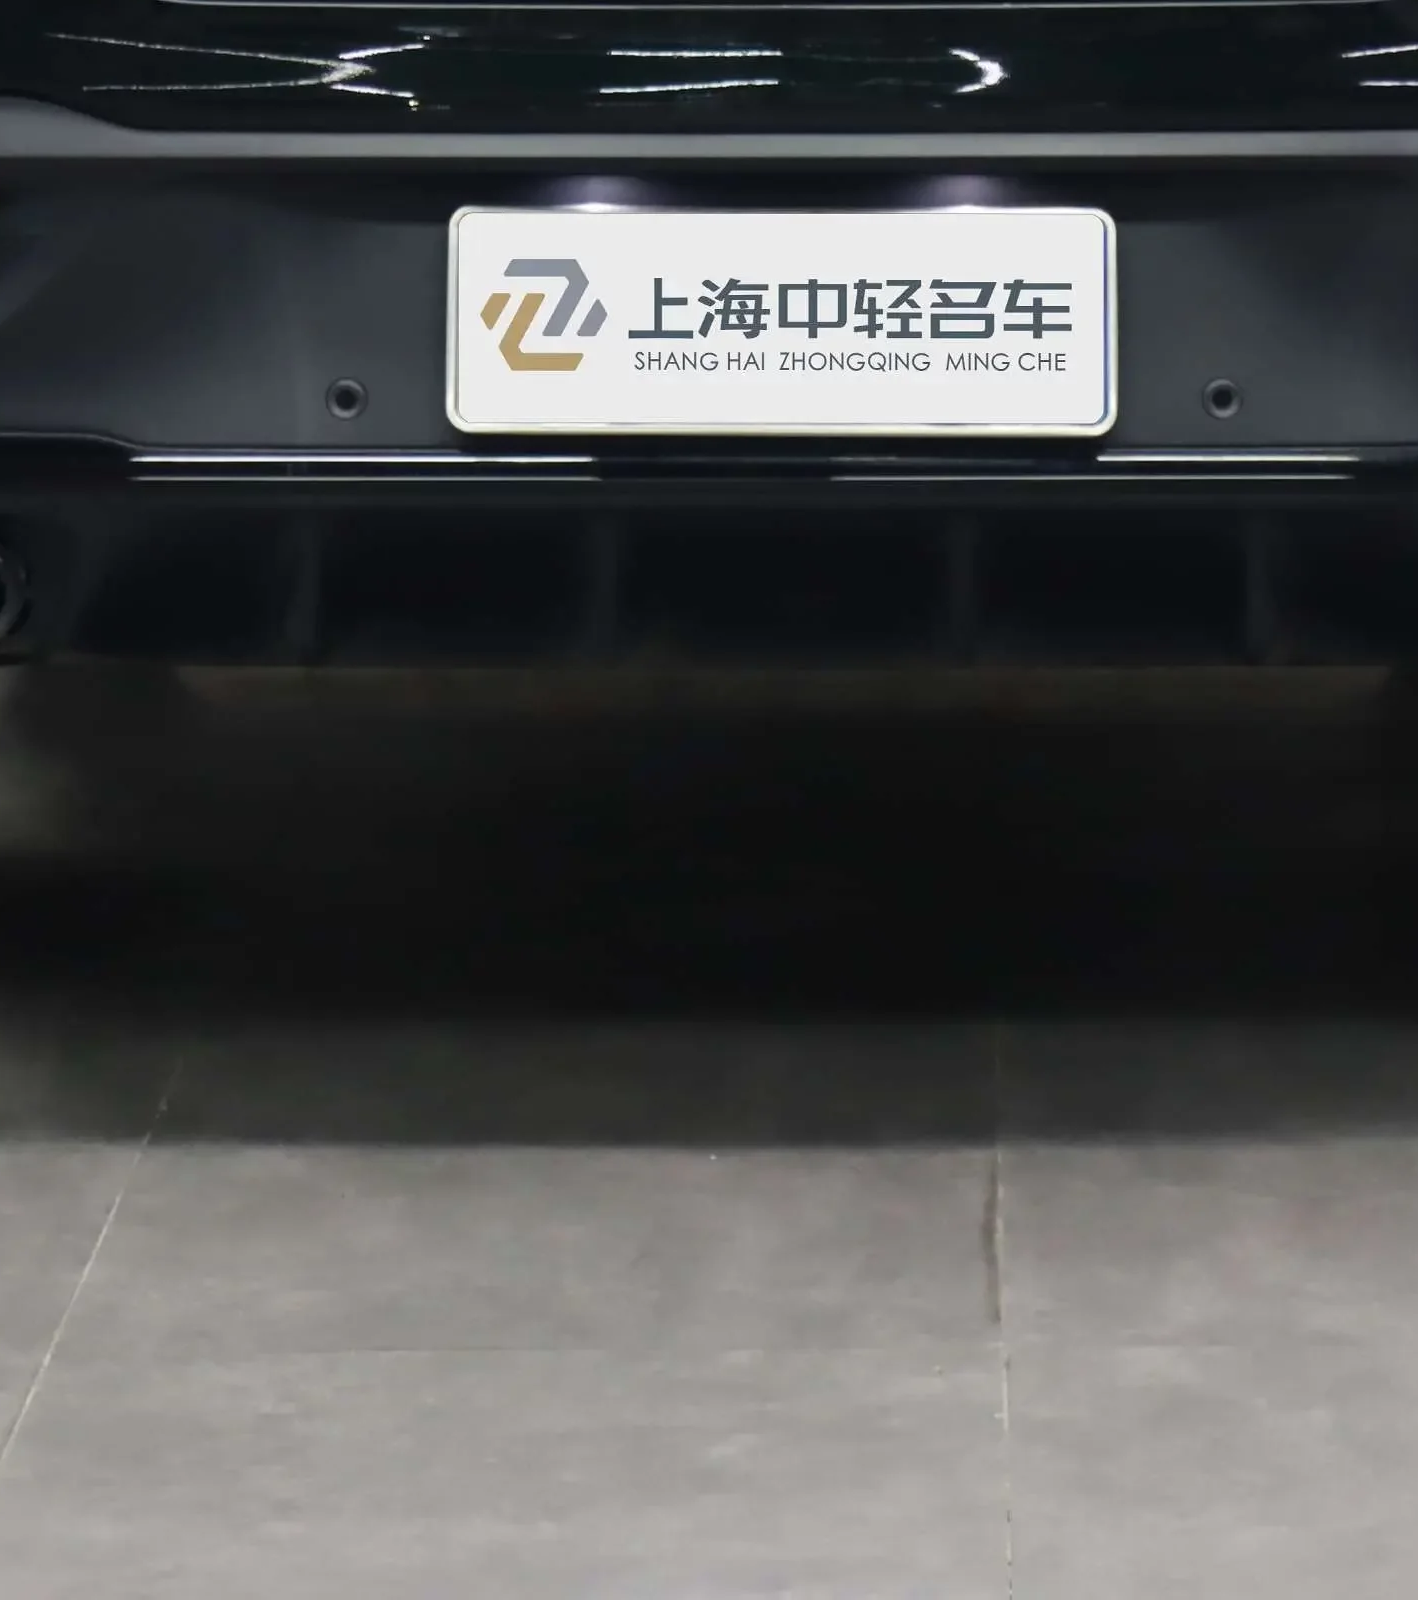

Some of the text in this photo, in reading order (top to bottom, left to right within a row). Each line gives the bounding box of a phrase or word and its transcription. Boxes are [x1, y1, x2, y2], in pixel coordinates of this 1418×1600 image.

[627, 277, 1073, 340] 上海中轻名车
[633, 351, 1067, 373] SHANG HAI ZHONGQING MING CHE
